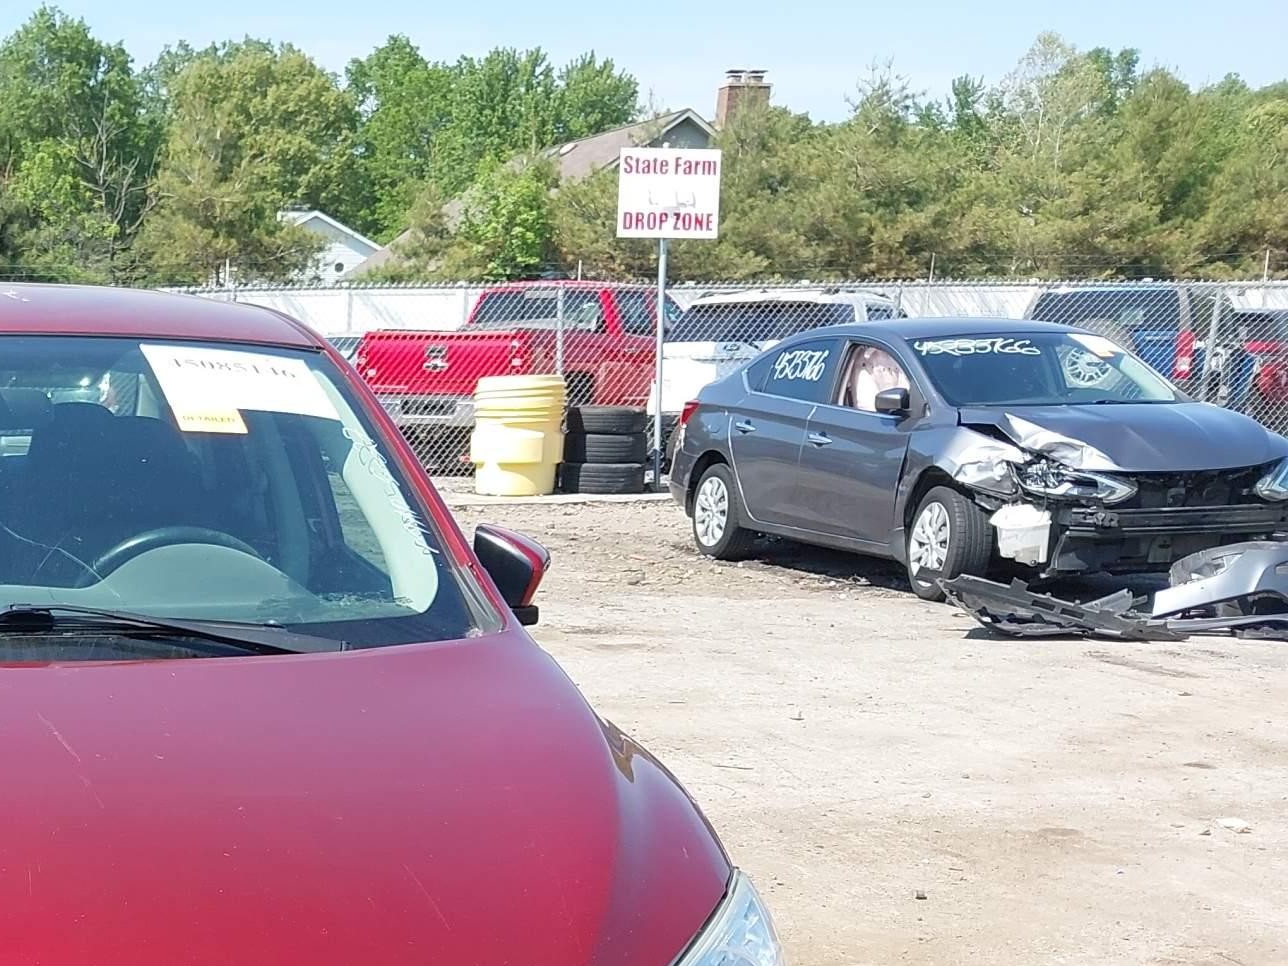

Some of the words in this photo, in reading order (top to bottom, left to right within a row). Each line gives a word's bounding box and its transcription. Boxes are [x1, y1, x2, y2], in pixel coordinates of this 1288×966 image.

[623, 155, 669, 175] State
[674, 156, 717, 176] Farm
[623, 212, 669, 231] DROP
[673, 212, 713, 232] ZONE
